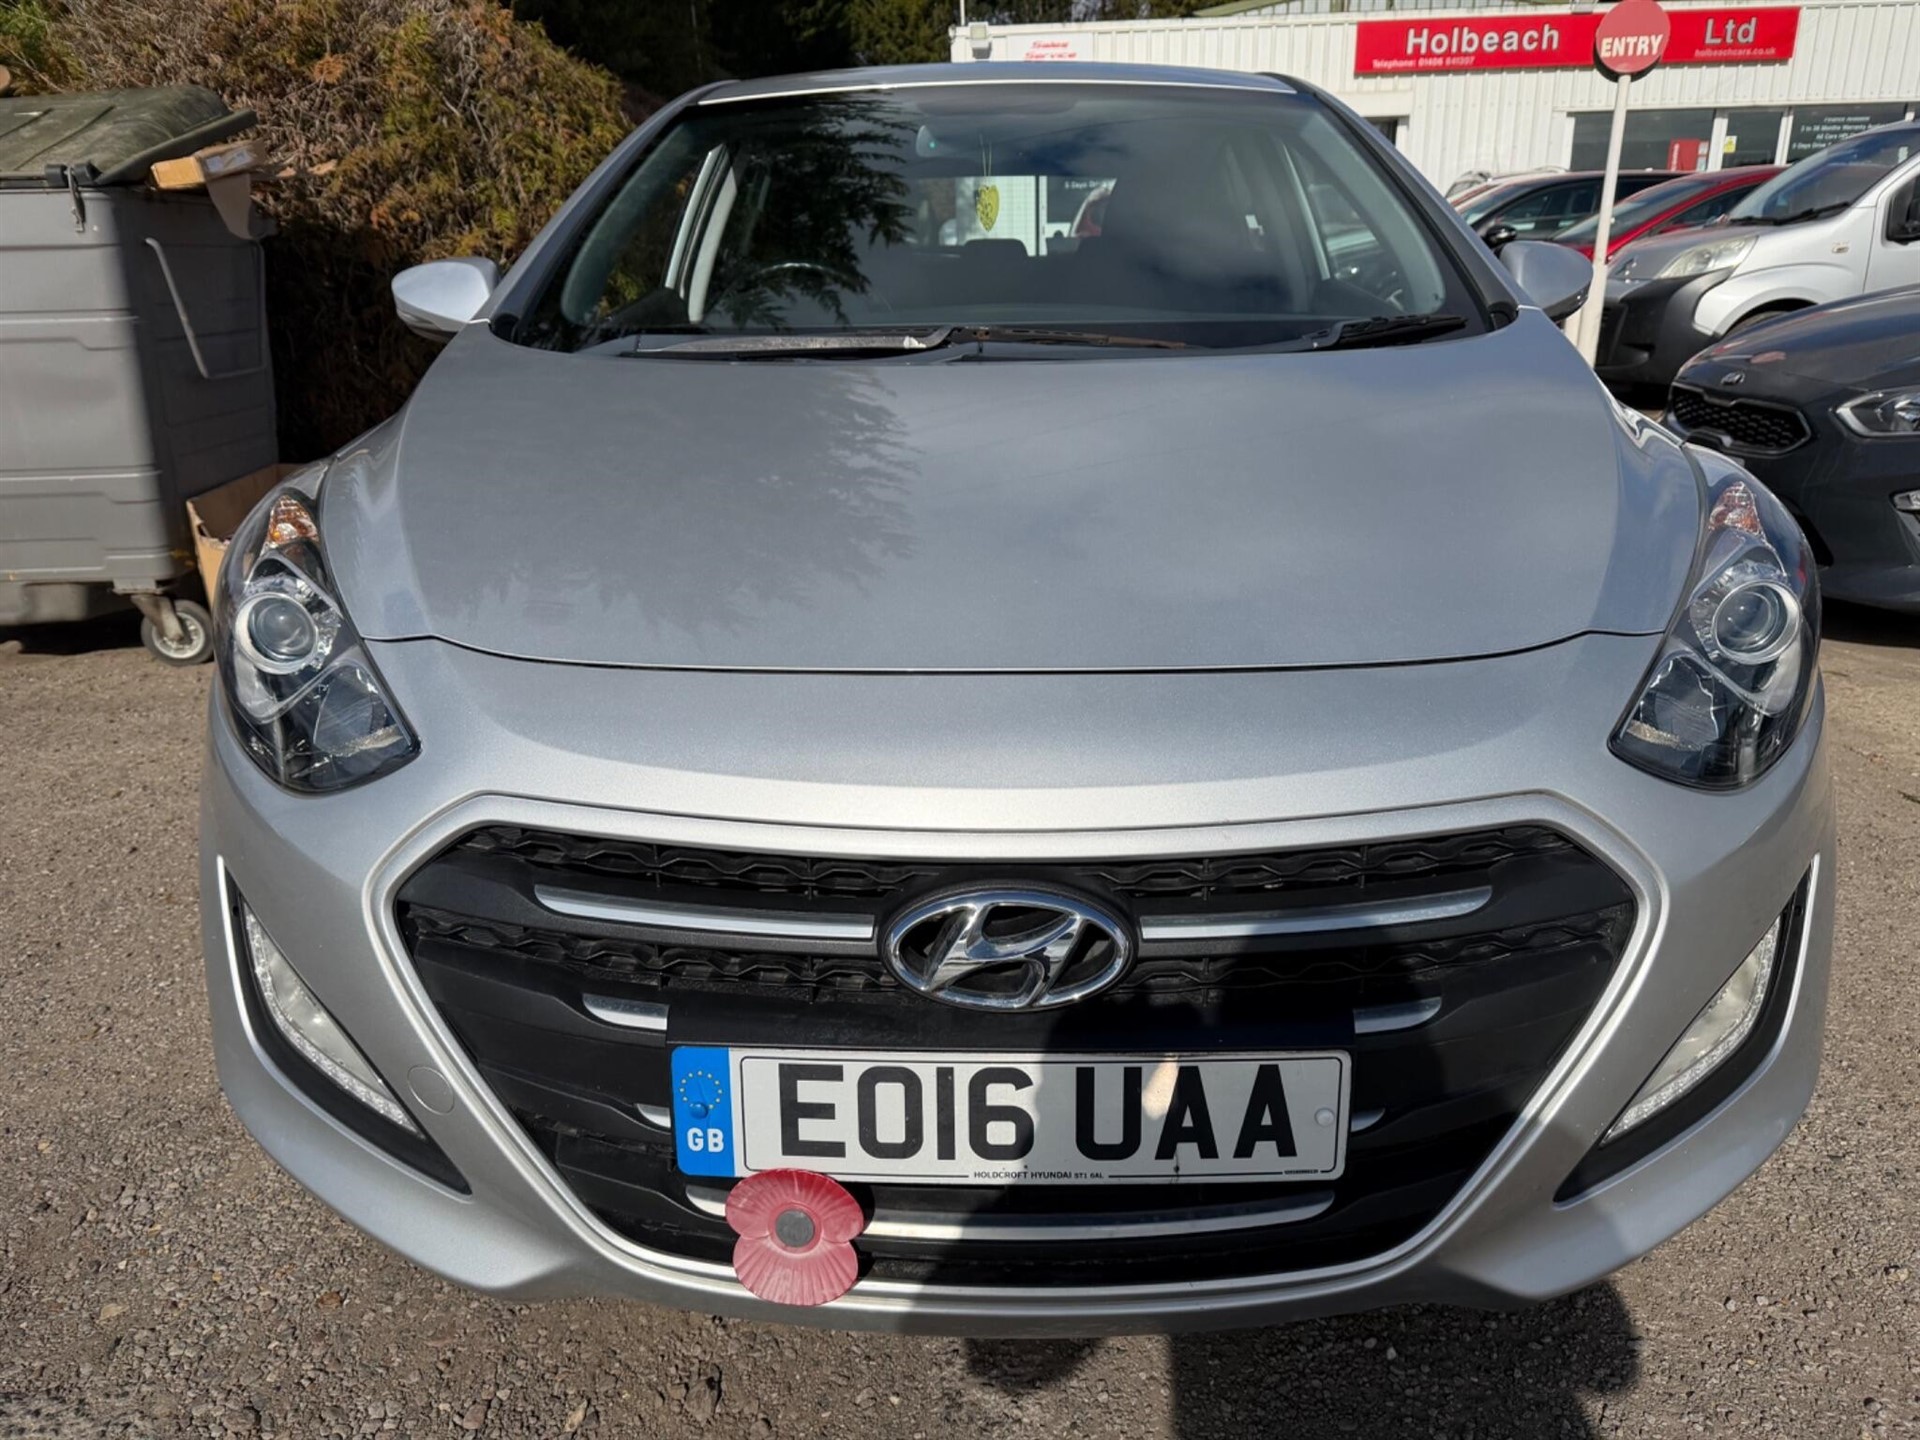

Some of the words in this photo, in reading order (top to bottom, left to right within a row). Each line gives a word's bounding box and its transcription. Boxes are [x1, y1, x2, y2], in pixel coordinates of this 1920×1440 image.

[1406, 23, 1559, 55] Holbeach
[1704, 17, 1757, 44] Ltd
[1600, 34, 1663, 58] ENTRY
[1372, 58, 1416, 70] Telephone:
[1797, 142, 1811, 150] Days
[779, 1062, 1034, 1161] EO16
[1075, 1063, 1298, 1161] UAA
[687, 1127, 725, 1153] GB
[974, 1171, 1028, 1179] HOLDCROFT
[1031, 1171, 1072, 1179] HYUNDAI
